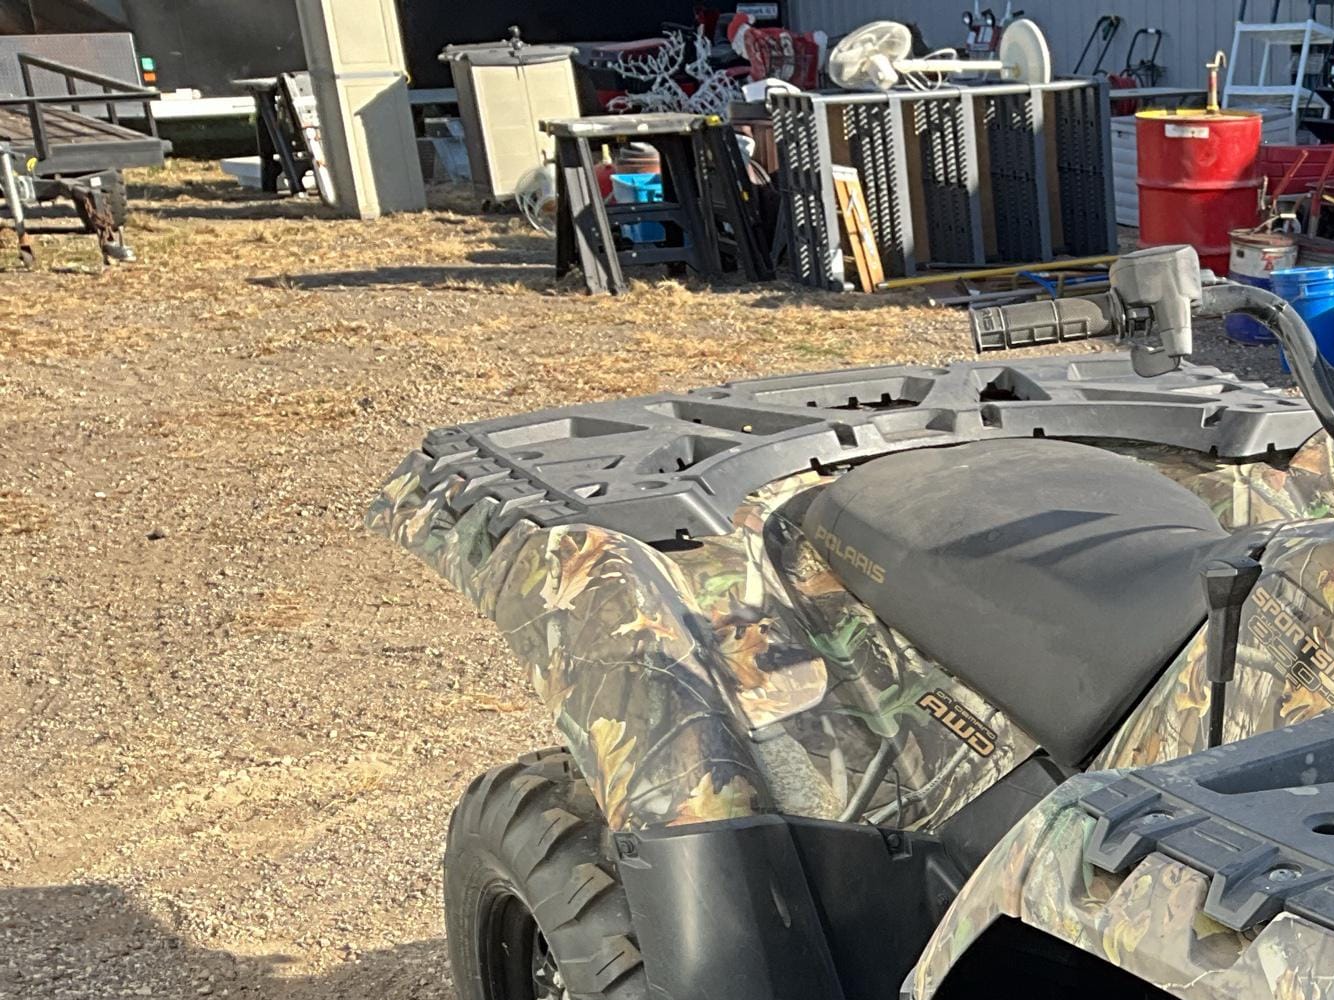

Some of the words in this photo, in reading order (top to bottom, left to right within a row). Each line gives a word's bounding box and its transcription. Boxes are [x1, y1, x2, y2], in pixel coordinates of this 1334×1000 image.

[815, 525, 886, 584] POLARIS
[1247, 614, 1322, 691] 850
[919, 694, 995, 756] AWD
